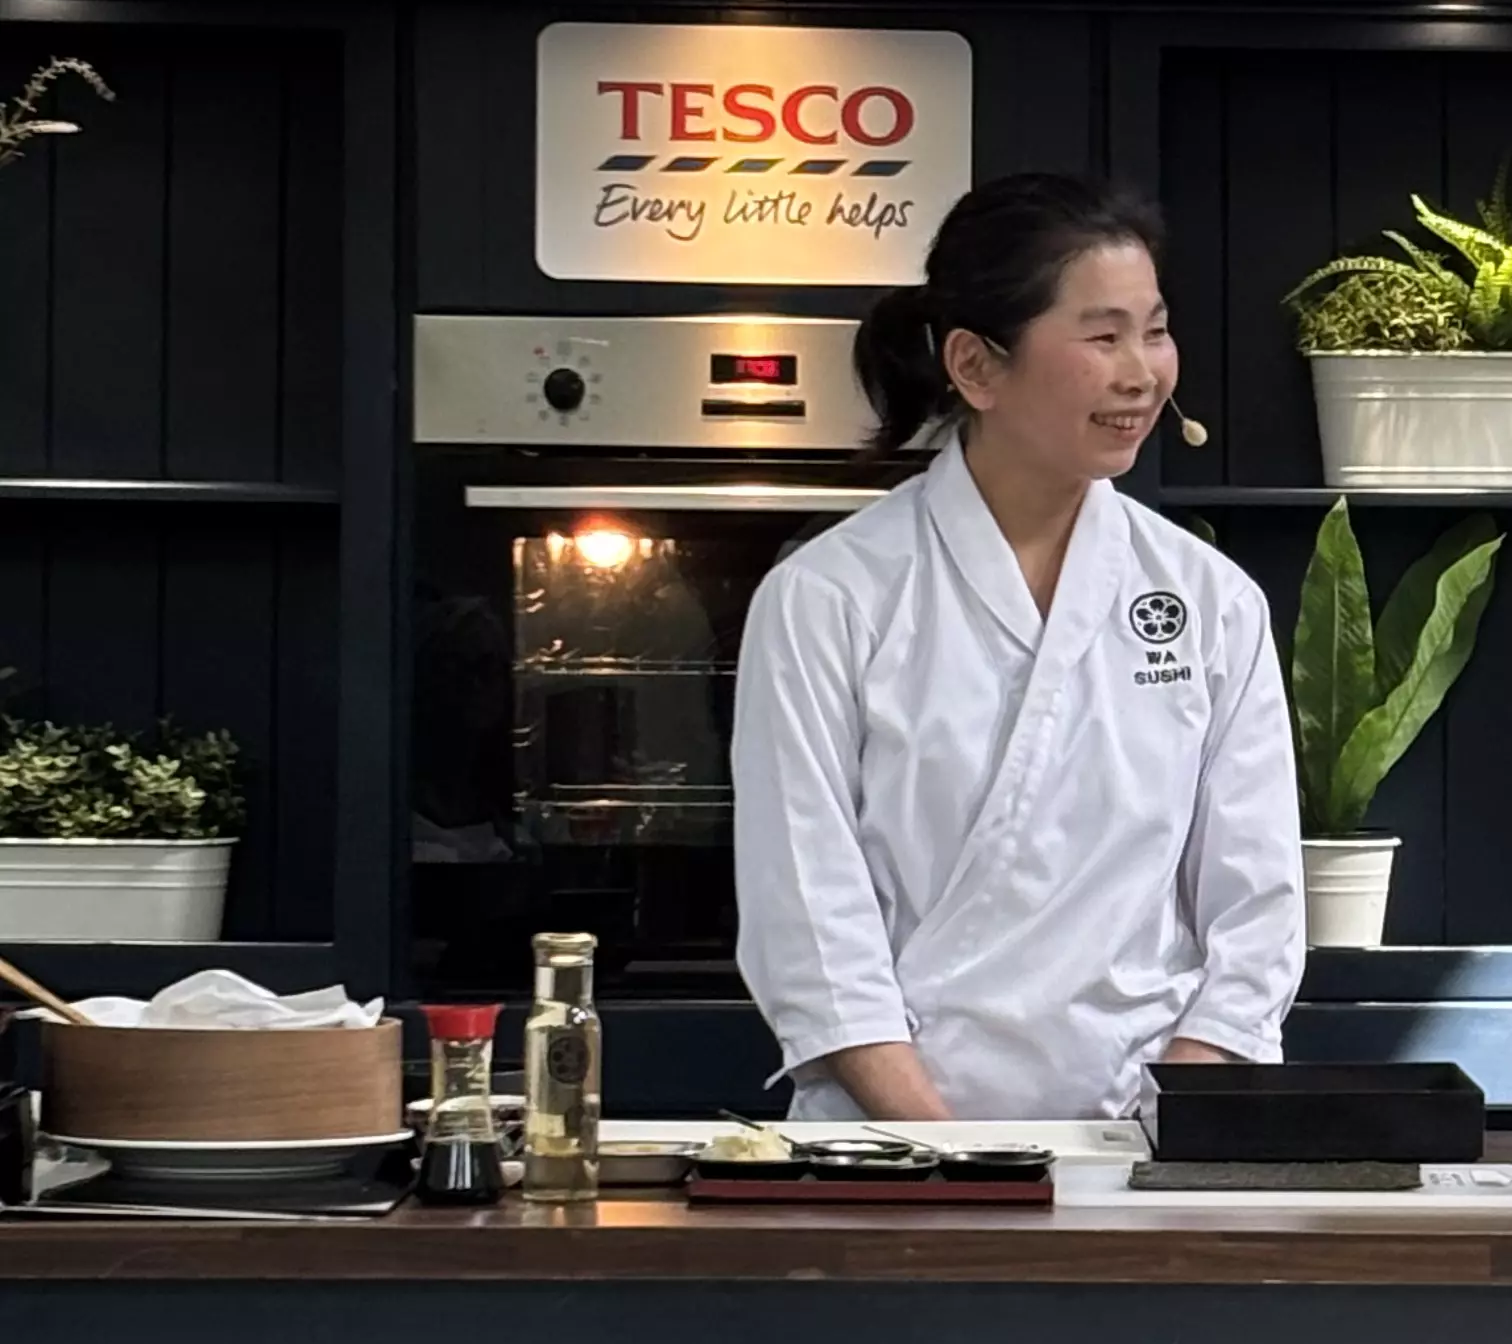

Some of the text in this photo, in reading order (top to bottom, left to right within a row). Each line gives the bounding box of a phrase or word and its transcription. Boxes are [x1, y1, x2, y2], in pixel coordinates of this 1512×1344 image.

[597, 81, 914, 146] TESCO
[594, 184, 915, 241] Every little helps
[1133, 666, 1192, 685] SUSHI
[1145, 650, 1178, 665] WA
